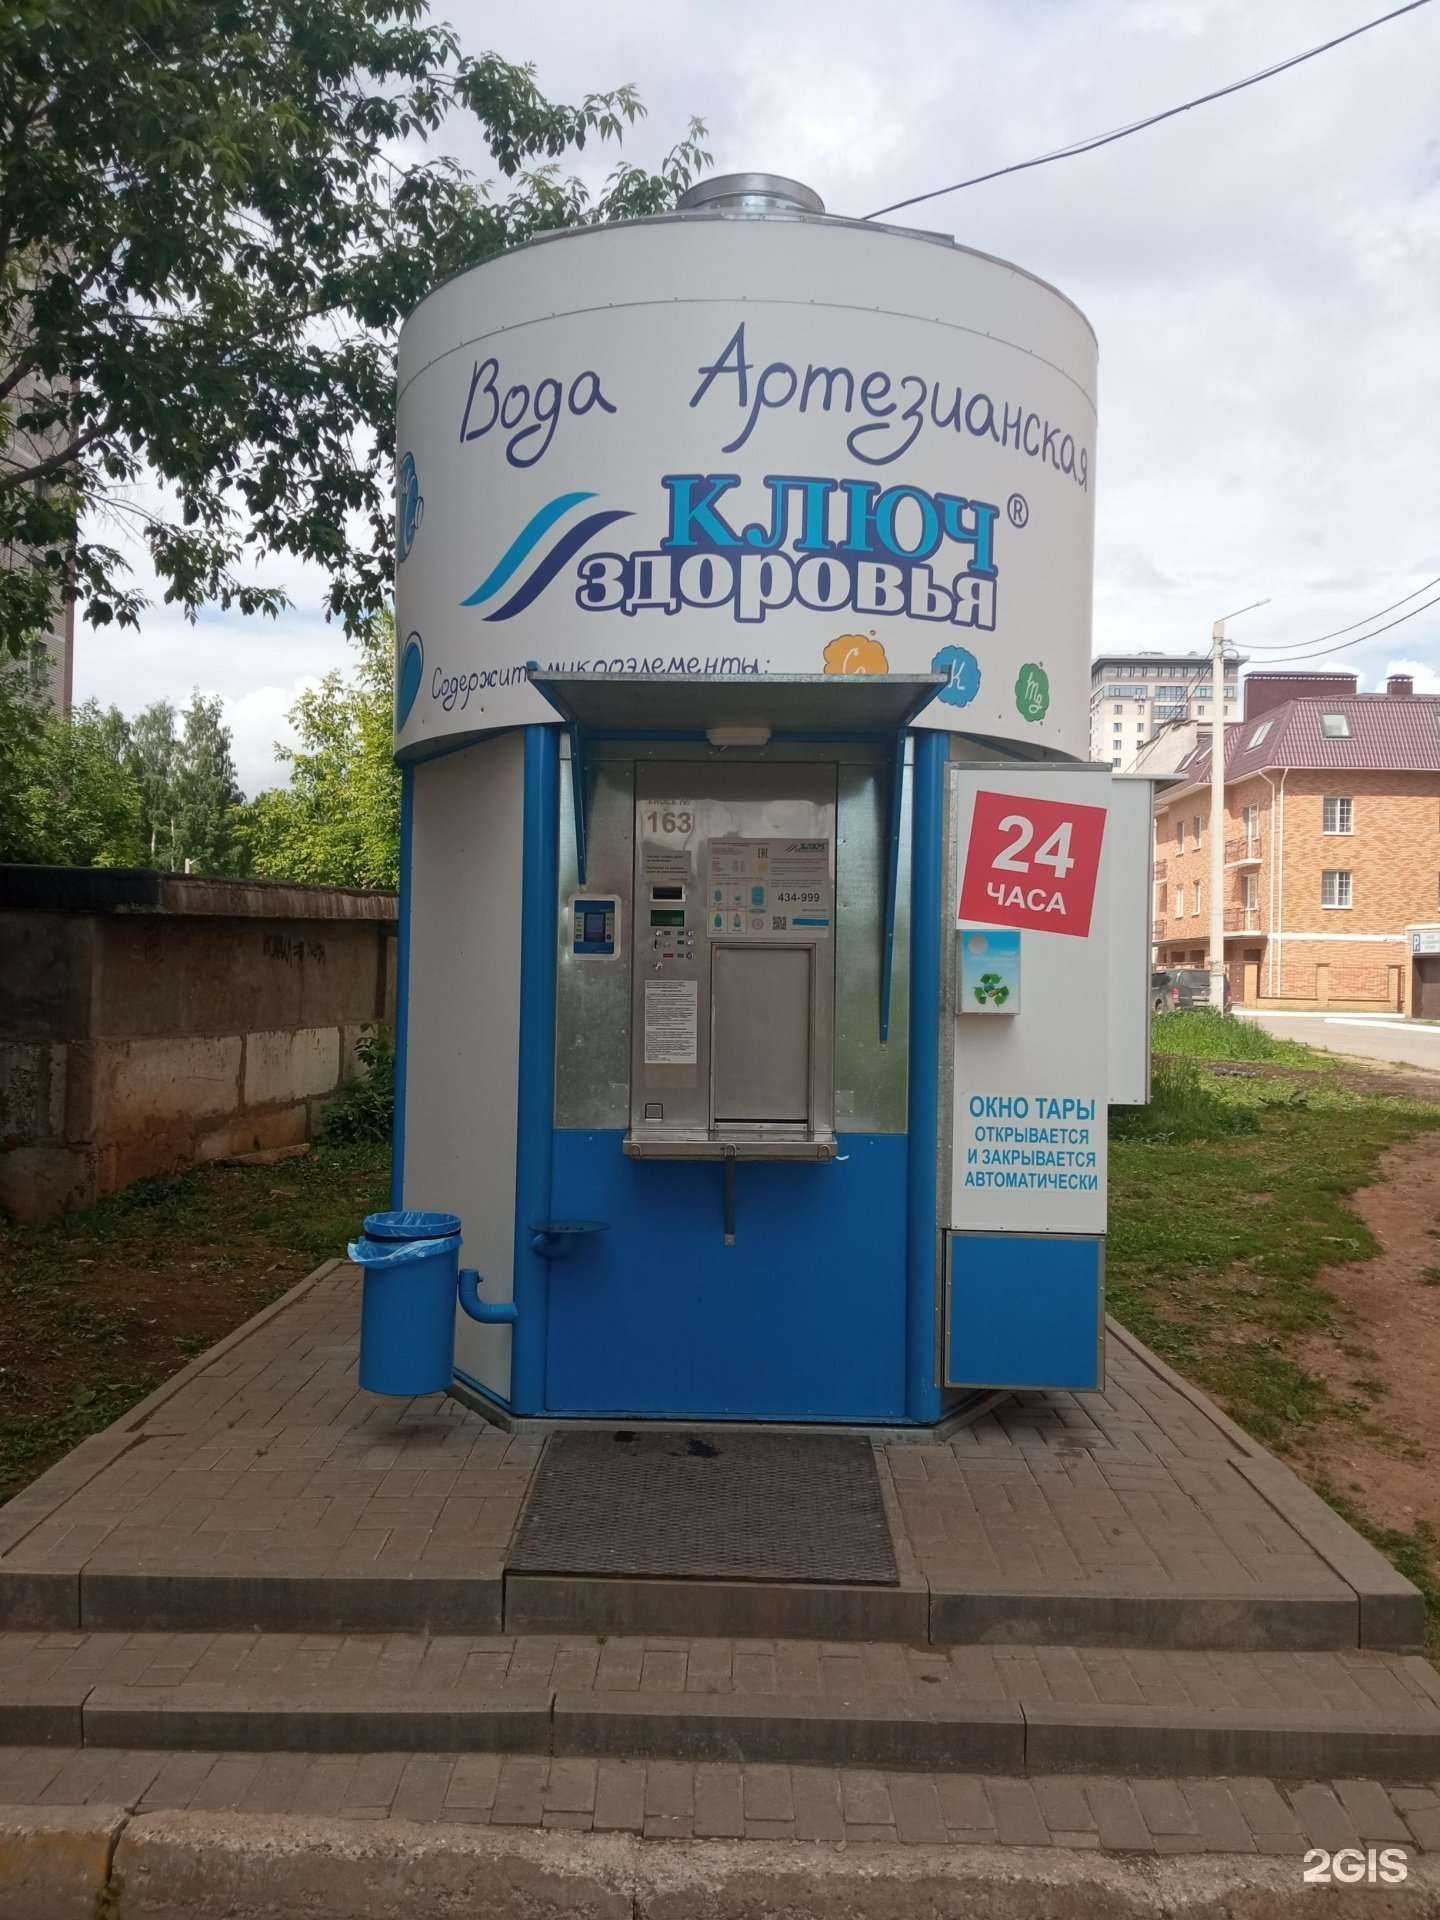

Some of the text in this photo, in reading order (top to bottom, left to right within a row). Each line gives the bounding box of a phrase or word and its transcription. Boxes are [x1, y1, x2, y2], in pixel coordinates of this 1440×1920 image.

[460, 320, 1088, 493] Вода Артезианская
[662, 474, 1000, 576] КЛЮЧ
[575, 549, 998, 631] здоровья
[431, 665, 528, 712] Содержит
[1024, 671, 1043, 714] Mg
[647, 811, 692, 834] 163
[991, 814, 1075, 879] 24
[777, 892, 820, 902] 434-999
[986, 881, 1067, 915] ЧАСА
[969, 1096, 1096, 1121] ОКНО ТАРЫ
[974, 1127, 1090, 1145] ОТКРЫВАЕТСЯ
[967, 1149, 1097, 1168] И ЗАКРЫВАЕТСЯ
[964, 1172, 1099, 1191] АВТОМАТИЧЕСКИ
